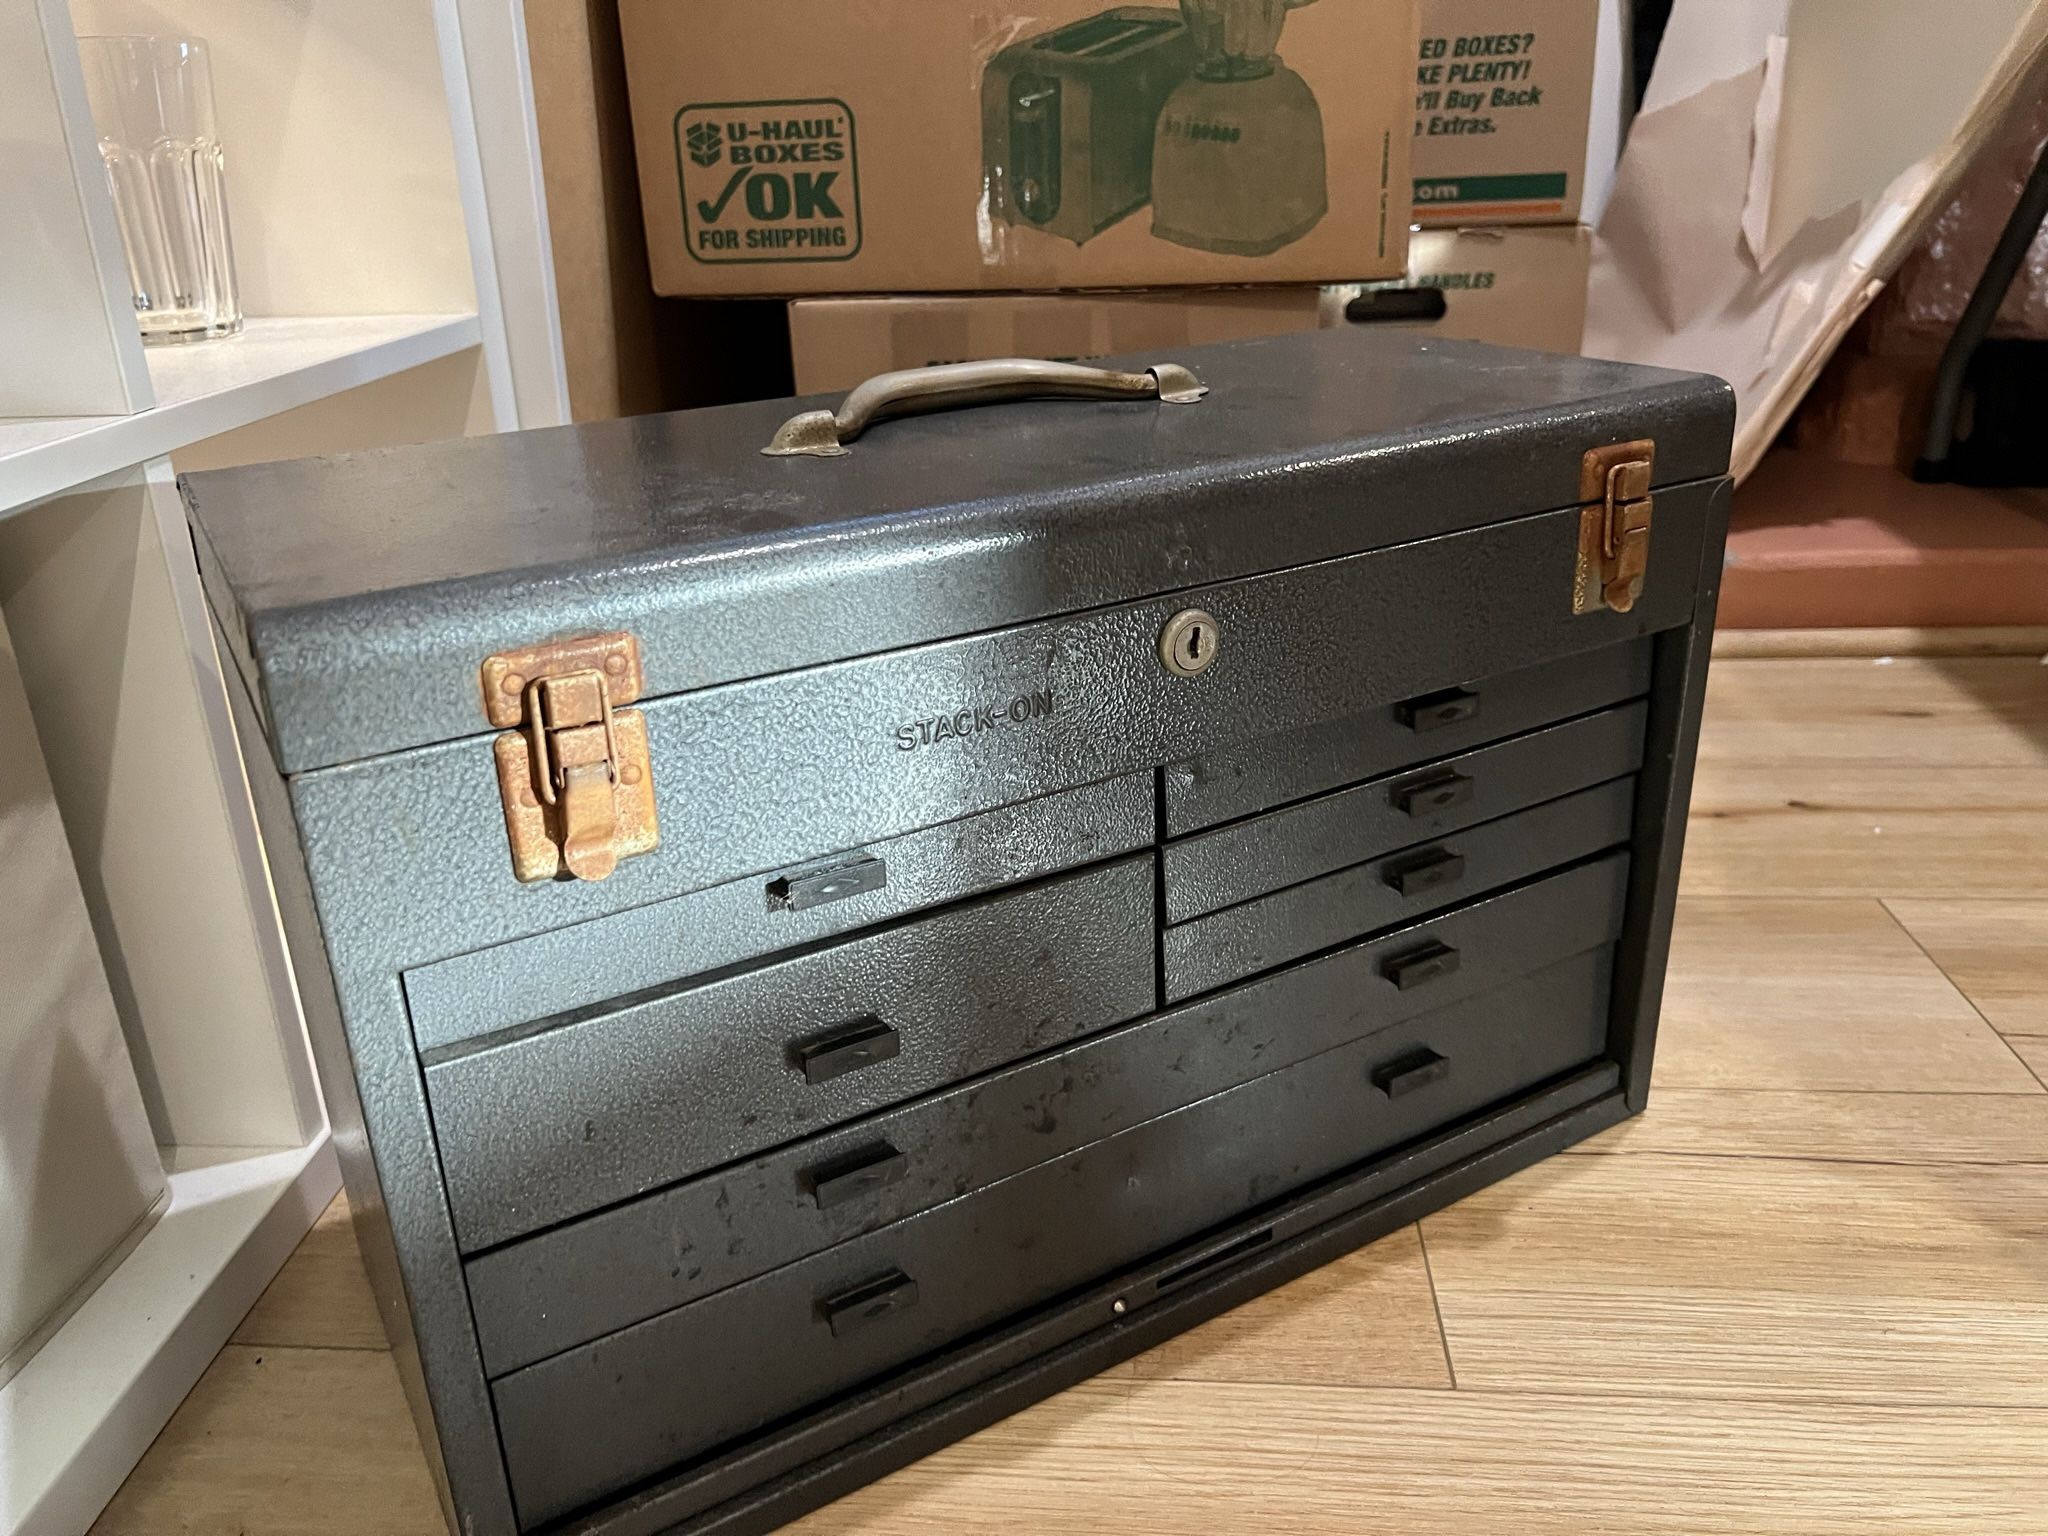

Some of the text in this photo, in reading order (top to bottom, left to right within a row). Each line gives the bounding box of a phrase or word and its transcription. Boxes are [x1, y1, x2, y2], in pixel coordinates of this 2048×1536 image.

[1453, 33, 1535, 57] BOXES?
[1447, 59, 1531, 83] PLENTY!
[1446, 89, 1485, 112] Buy
[1491, 84, 1543, 108] Back
[727, 119, 843, 142] U-HAUL
[1427, 116, 1496, 135] Extras.
[730, 142, 844, 164] BOXES
[746, 172, 844, 221] OK
[699, 226, 847, 250] FOR SHIPPING
[897, 688, 1054, 750] STACK-ON
